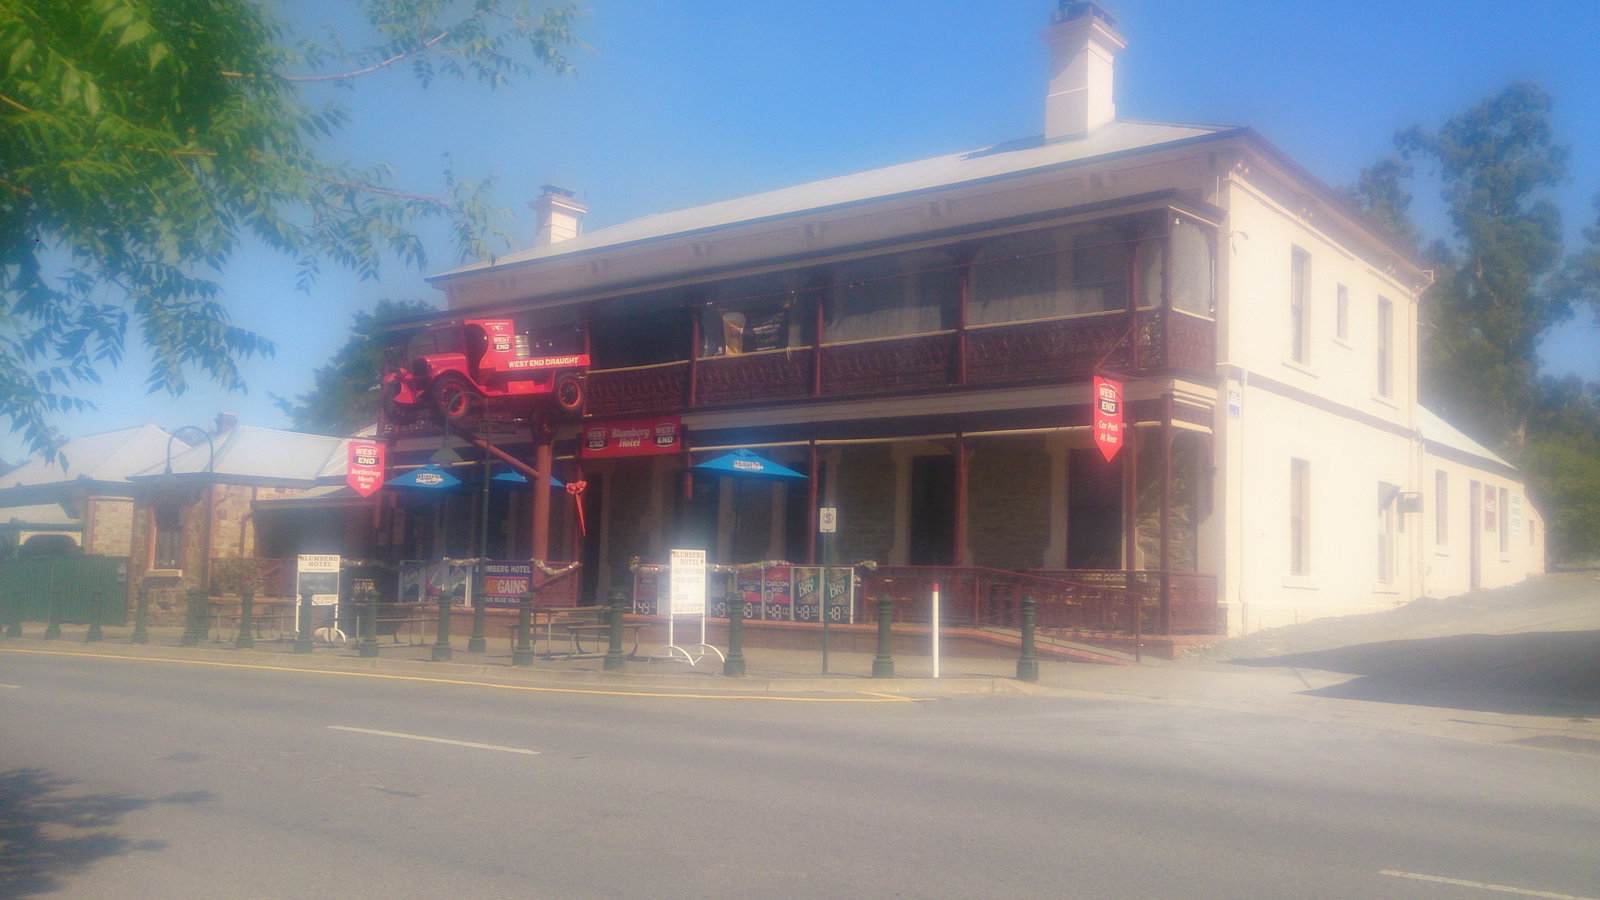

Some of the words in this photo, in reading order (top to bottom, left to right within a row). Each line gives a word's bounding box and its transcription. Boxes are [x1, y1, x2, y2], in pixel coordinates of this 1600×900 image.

[508, 360, 529, 369] WEST
[529, 359, 545, 367] END
[545, 357, 579, 366] DRAUGHT
[1099, 386, 1116, 399] WEST
[1102, 401, 1115, 412] END
[655, 426, 676, 434] WEST
[1099, 420, 1108, 429] Car
[1108, 422, 1118, 432] Park
[611, 426, 650, 439] Blumberg
[588, 440, 605, 448] END
[618, 438, 641, 448] Hotel
[656, 436, 674, 444] END
[510, 565, 532, 574] HOTEL
[766, 604, 782, 620] 48
[797, 605, 810, 620] 48
